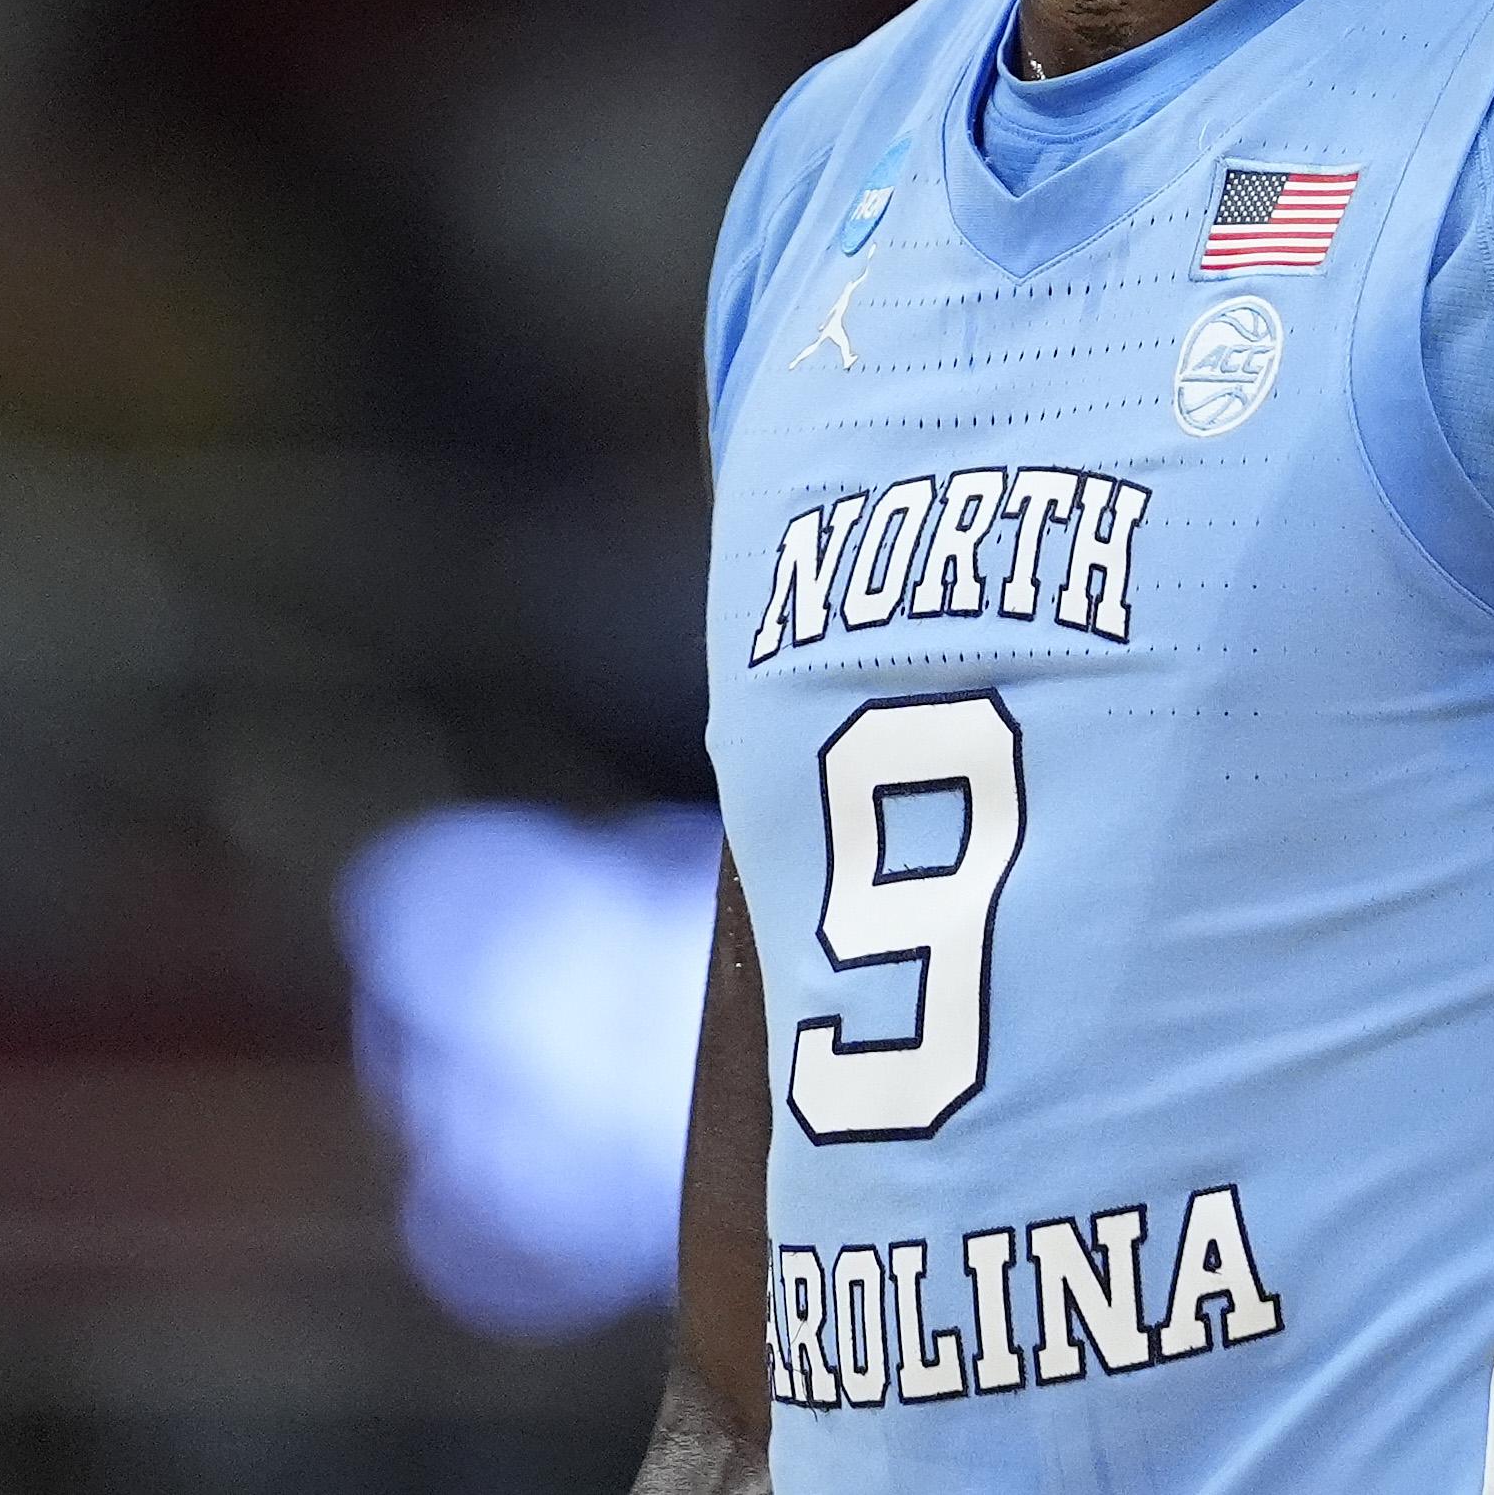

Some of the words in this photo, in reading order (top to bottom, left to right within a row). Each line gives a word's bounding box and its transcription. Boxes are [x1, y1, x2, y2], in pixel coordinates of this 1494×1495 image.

[1192, 345, 1275, 375] ACC
[748, 465, 1153, 668] NORTH
[786, 687, 1028, 1146] 9
[766, 1182, 1286, 1410] AROLINA
